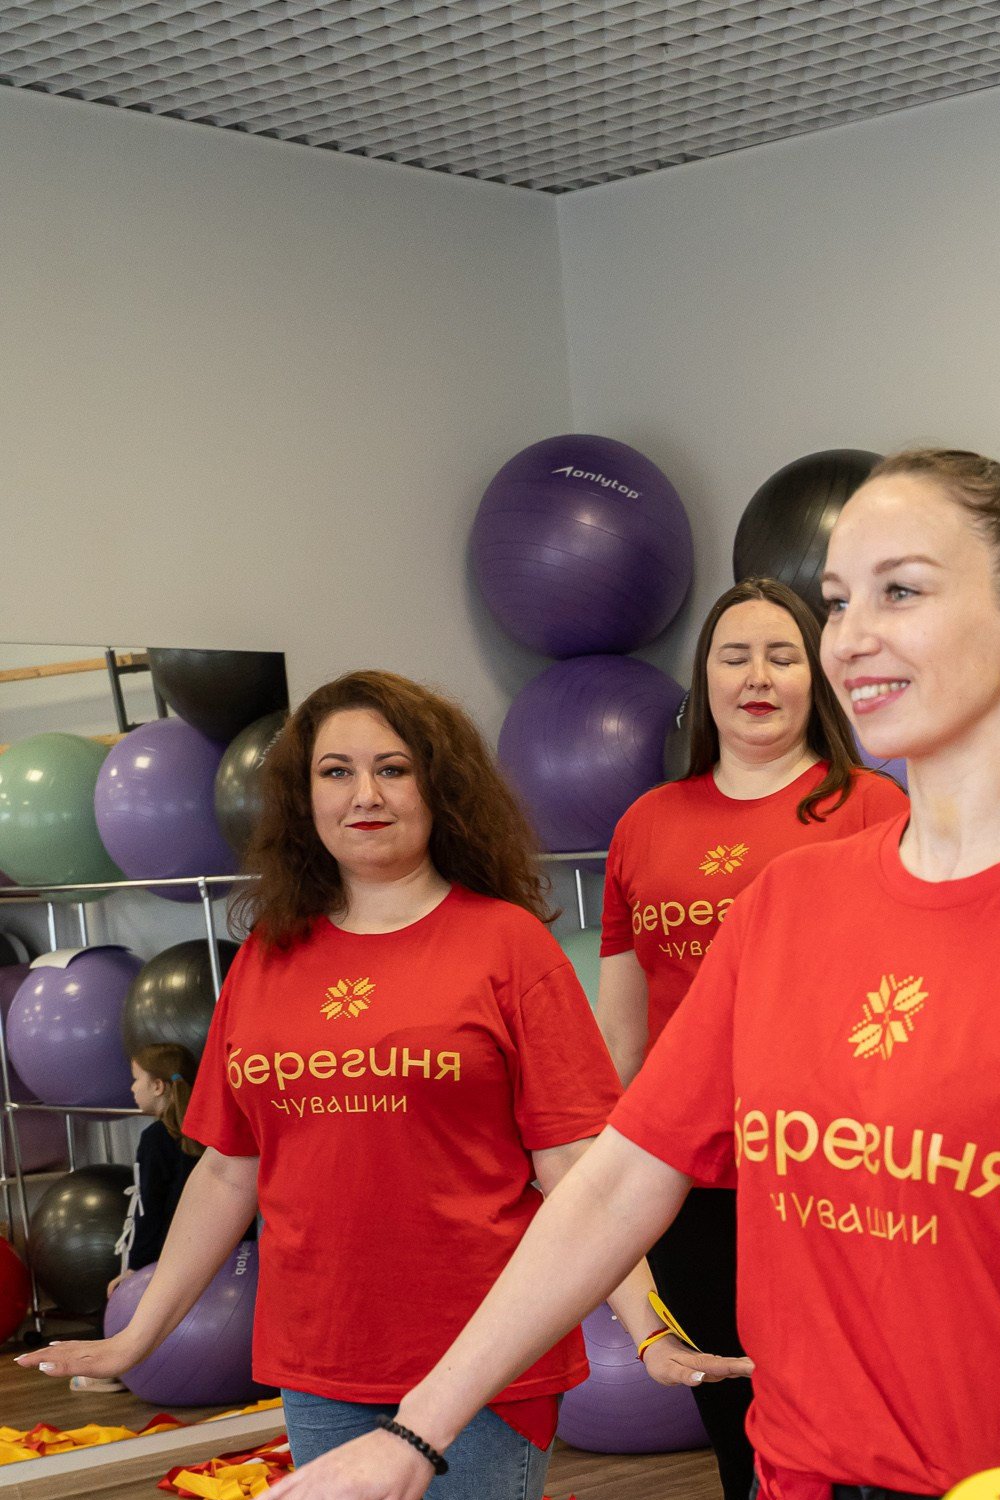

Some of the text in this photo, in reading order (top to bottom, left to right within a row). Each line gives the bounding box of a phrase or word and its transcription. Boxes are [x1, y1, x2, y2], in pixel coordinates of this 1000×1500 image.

[632, 897, 736, 936] берег
[227, 1046, 462, 1091] берегиня
[270, 1094, 408, 1118] чувашии
[769, 1192, 939, 1245] чувашии
